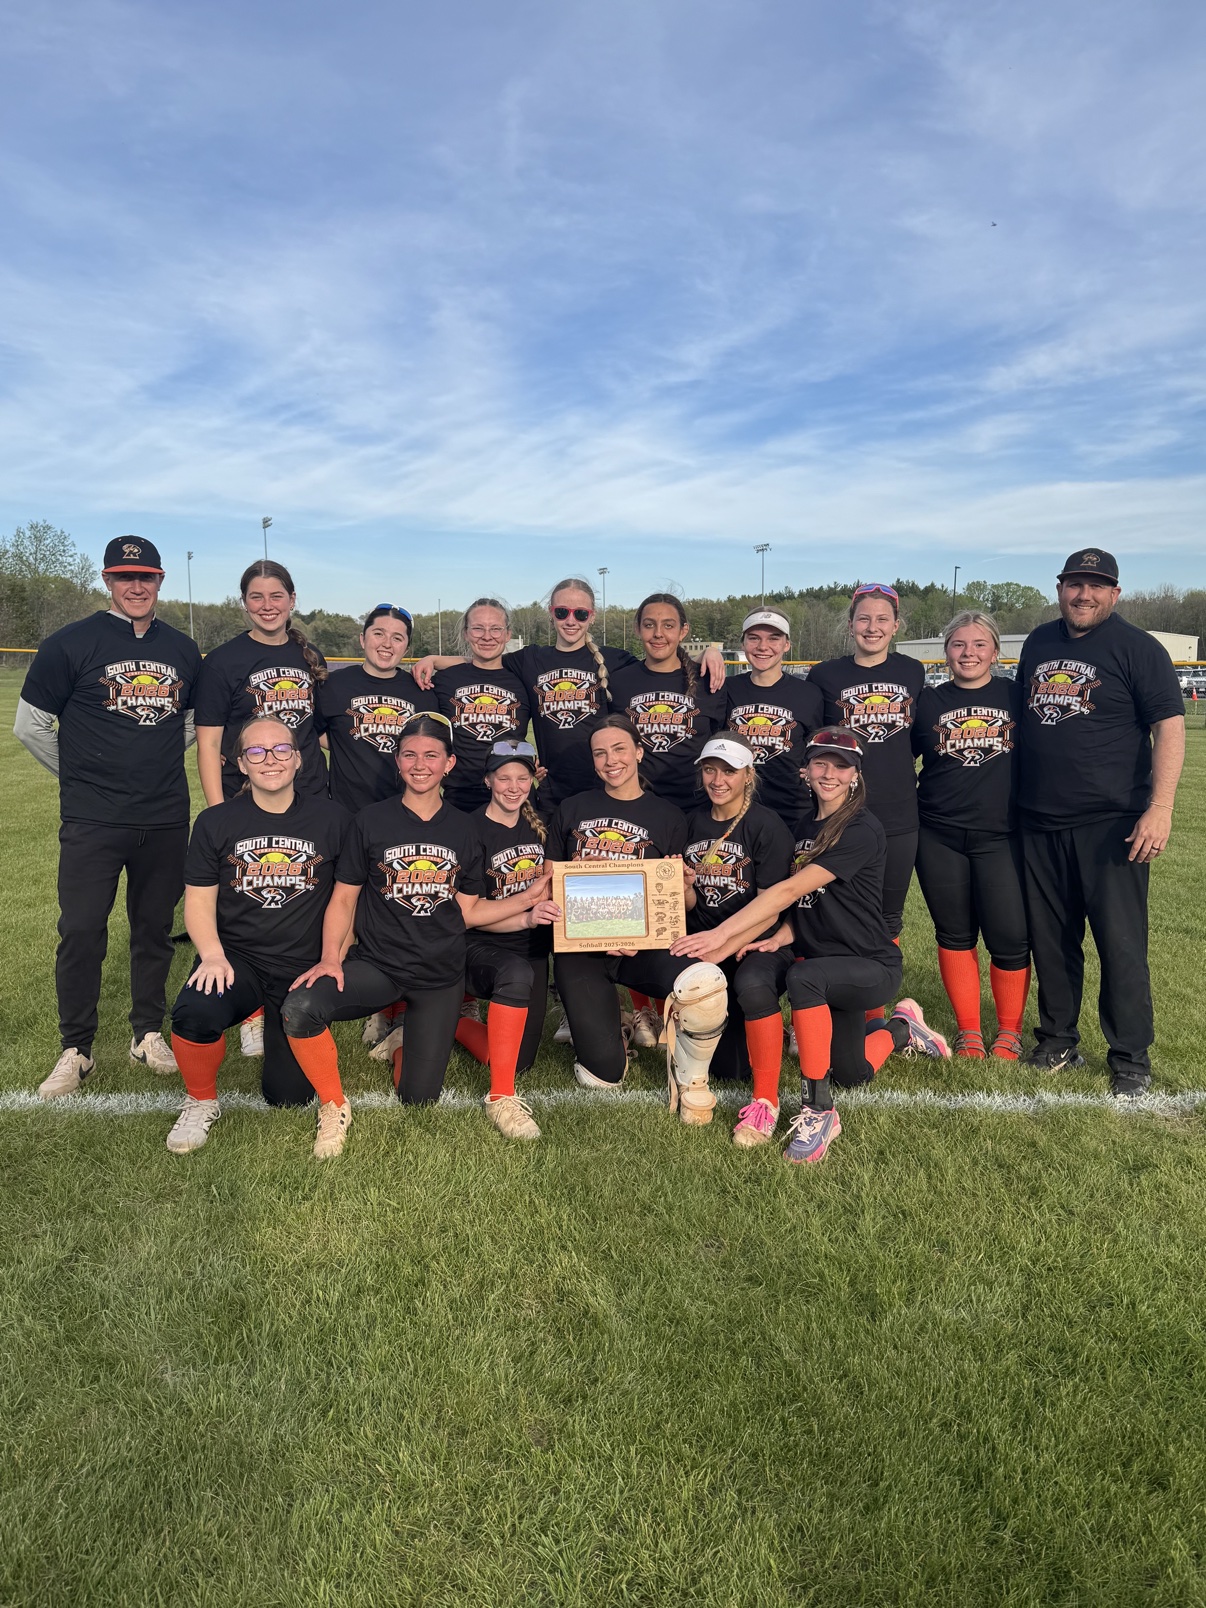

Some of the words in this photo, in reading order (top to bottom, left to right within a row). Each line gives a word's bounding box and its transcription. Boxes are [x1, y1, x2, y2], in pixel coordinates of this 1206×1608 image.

[107, 661, 136, 677] SOUTH
[139, 661, 177, 680] CENTRAL
[251, 668, 277, 685] SOUTH
[538, 670, 560, 686] SOUTH
[562, 669, 597, 684] CENTRAL
[1035, 661, 1060, 676] SOUTH
[1061, 660, 1096, 680] CENTRAL
[121, 683, 170, 697] 2026
[265, 688, 309, 701] 2026
[456, 685, 480, 698] SOUTH
[483, 685, 517, 702] CENTRAL
[545, 689, 587, 702] 2026
[842, 684, 869, 700] SOUTH
[872, 683, 910, 698] CENTRAL
[1037, 681, 1081, 696] 2026
[117, 696, 173, 711] CHAMPS
[263, 700, 311, 715] CHAMPS
[352, 696, 378, 710] SOUTH
[381, 696, 415, 714] CENTRAL
[543, 700, 590, 715] CHAMPS
[631, 692, 656, 707] SOUTH
[658, 692, 695, 709] CENTRAL
[853, 702, 901, 715] 2026
[1033, 694, 1082, 711] CHAMPS
[463, 703, 508, 715] 2026
[731, 705, 755, 720] SOUTH
[757, 704, 794, 721] CENTRAL
[940, 708, 967, 724] SOUTH
[971, 707, 1010, 722] CENTRAL
[460, 713, 511, 728] CHAMPS
[638, 712, 684, 725] 2026
[850, 713, 905, 728] CHAMPS
[360, 723, 403, 737] CHAMP
[636, 723, 687, 738] CHAMPS
[738, 724, 783, 737] 2026
[949, 726, 1000, 740] 2026
[747, 736, 785, 750] AMPS
[946, 737, 1003, 754] CHAMPS
[580, 819, 609, 830] SOUTH
[611, 819, 649, 840] CENTRAL
[236, 837, 268, 855] SOUTH
[272, 837, 315, 855] CENTRAL
[585, 837, 636, 854] 2026
[385, 845, 416, 862] SOUTH
[420, 845, 457, 865] CENTRAL
[491, 848, 517, 869] SOUTH
[246, 862, 303, 876] 2026
[395, 869, 448, 883] 2026
[505, 865, 544, 885] 2026
[695, 862, 733, 876] 2026
[242, 875, 306, 891] CHAMPS
[393, 883, 450, 899] CHAMPS
[695, 875, 737, 891] CHAMPS
